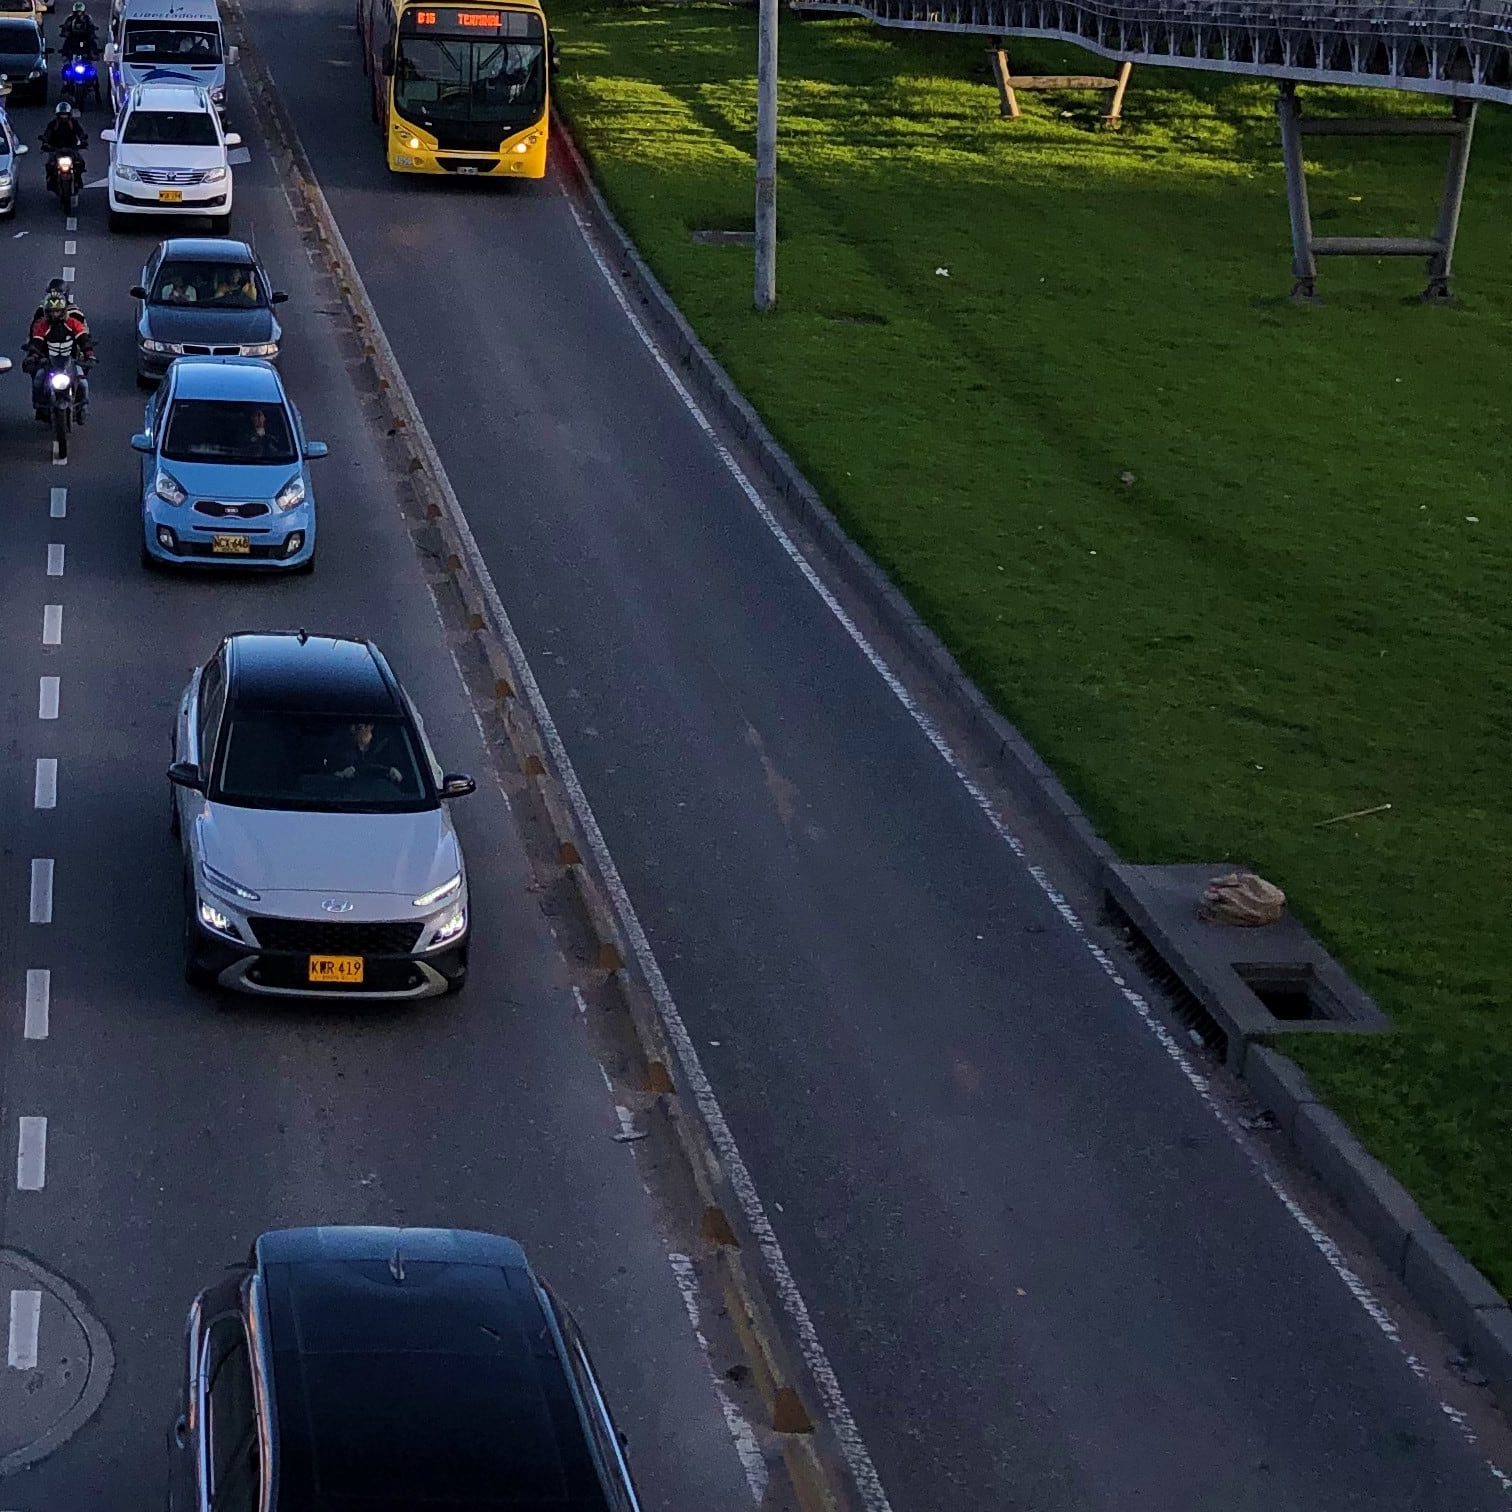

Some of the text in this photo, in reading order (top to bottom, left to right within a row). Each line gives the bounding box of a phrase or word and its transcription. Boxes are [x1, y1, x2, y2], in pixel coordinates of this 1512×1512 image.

[458, 13, 502, 26] TERMINAL
[311, 961, 361, 976] KWR 419
